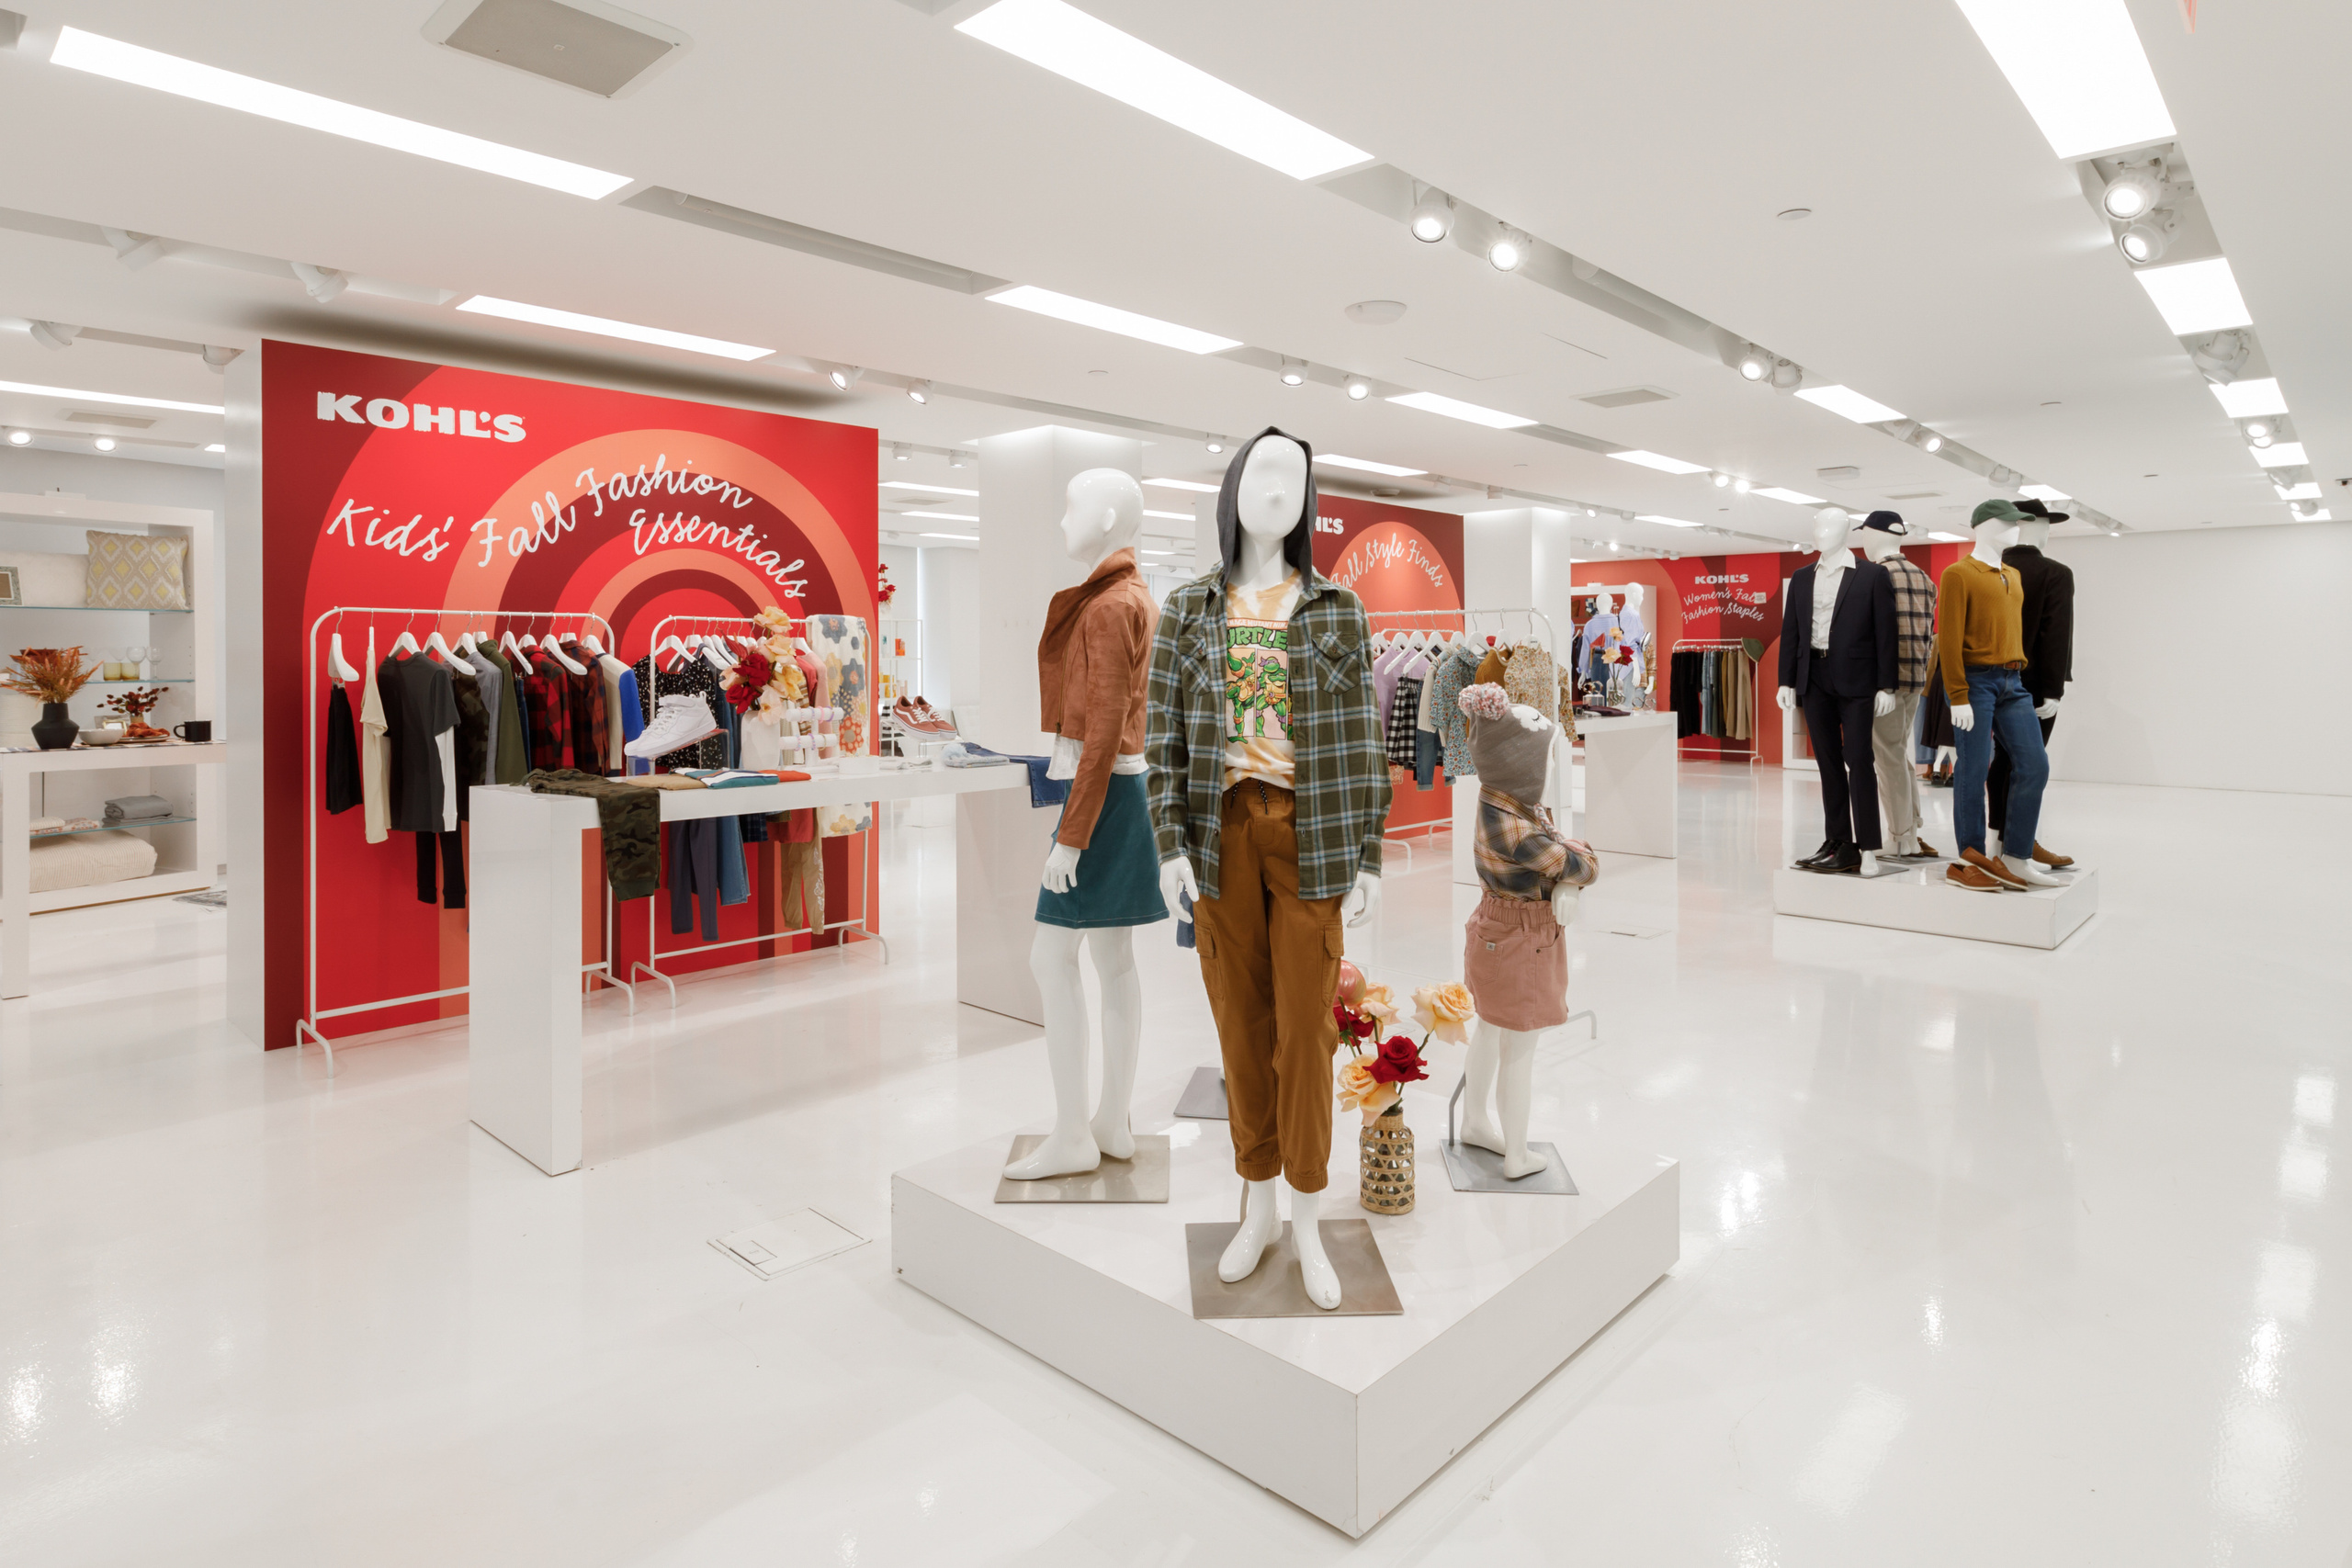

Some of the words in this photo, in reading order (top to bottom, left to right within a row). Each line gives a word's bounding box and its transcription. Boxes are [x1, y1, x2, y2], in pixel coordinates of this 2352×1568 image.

[317, 391, 526, 443] KOHL'S
[326, 499, 454, 562] Kids'
[470, 491, 576, 568] Fall
[575, 454, 753, 517] Fashion
[629, 509, 808, 598] Essentials
[1330, 551, 1363, 588] Fall
[1365, 532, 1405, 574] Style
[1407, 539, 1443, 587] Finds
[1694, 573, 1749, 584] KOHL'S
[1681, 604, 1724, 625] Fashion
[1724, 602, 1764, 622] Staples
[1683, 587, 1732, 606] Women's
[1735, 588, 1757, 603] Fal
